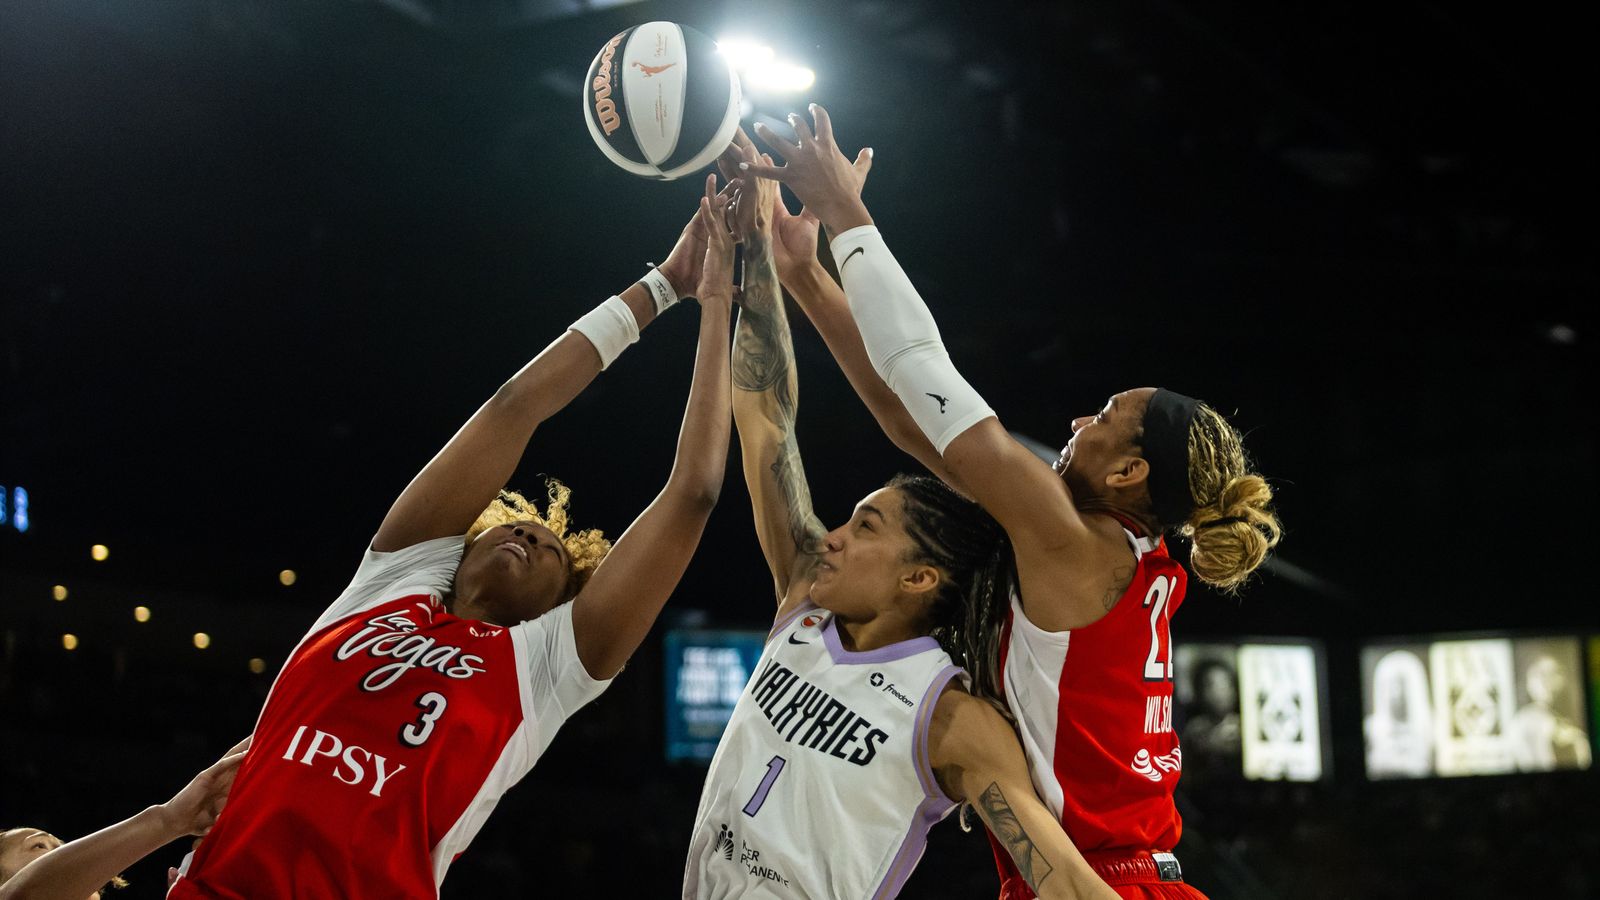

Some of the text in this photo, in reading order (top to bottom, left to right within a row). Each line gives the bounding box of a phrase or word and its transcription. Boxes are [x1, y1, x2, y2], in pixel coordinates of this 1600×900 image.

[593, 31, 626, 136] Wilson
[334, 625, 487, 692] Vegas
[399, 692, 447, 748] 3
[751, 658, 889, 766] VALKYRIES
[882, 683, 914, 708] freedom
[1144, 695, 1172, 734] WILSO
[282, 725, 407, 797] IPSY
[742, 755, 787, 818] 1
